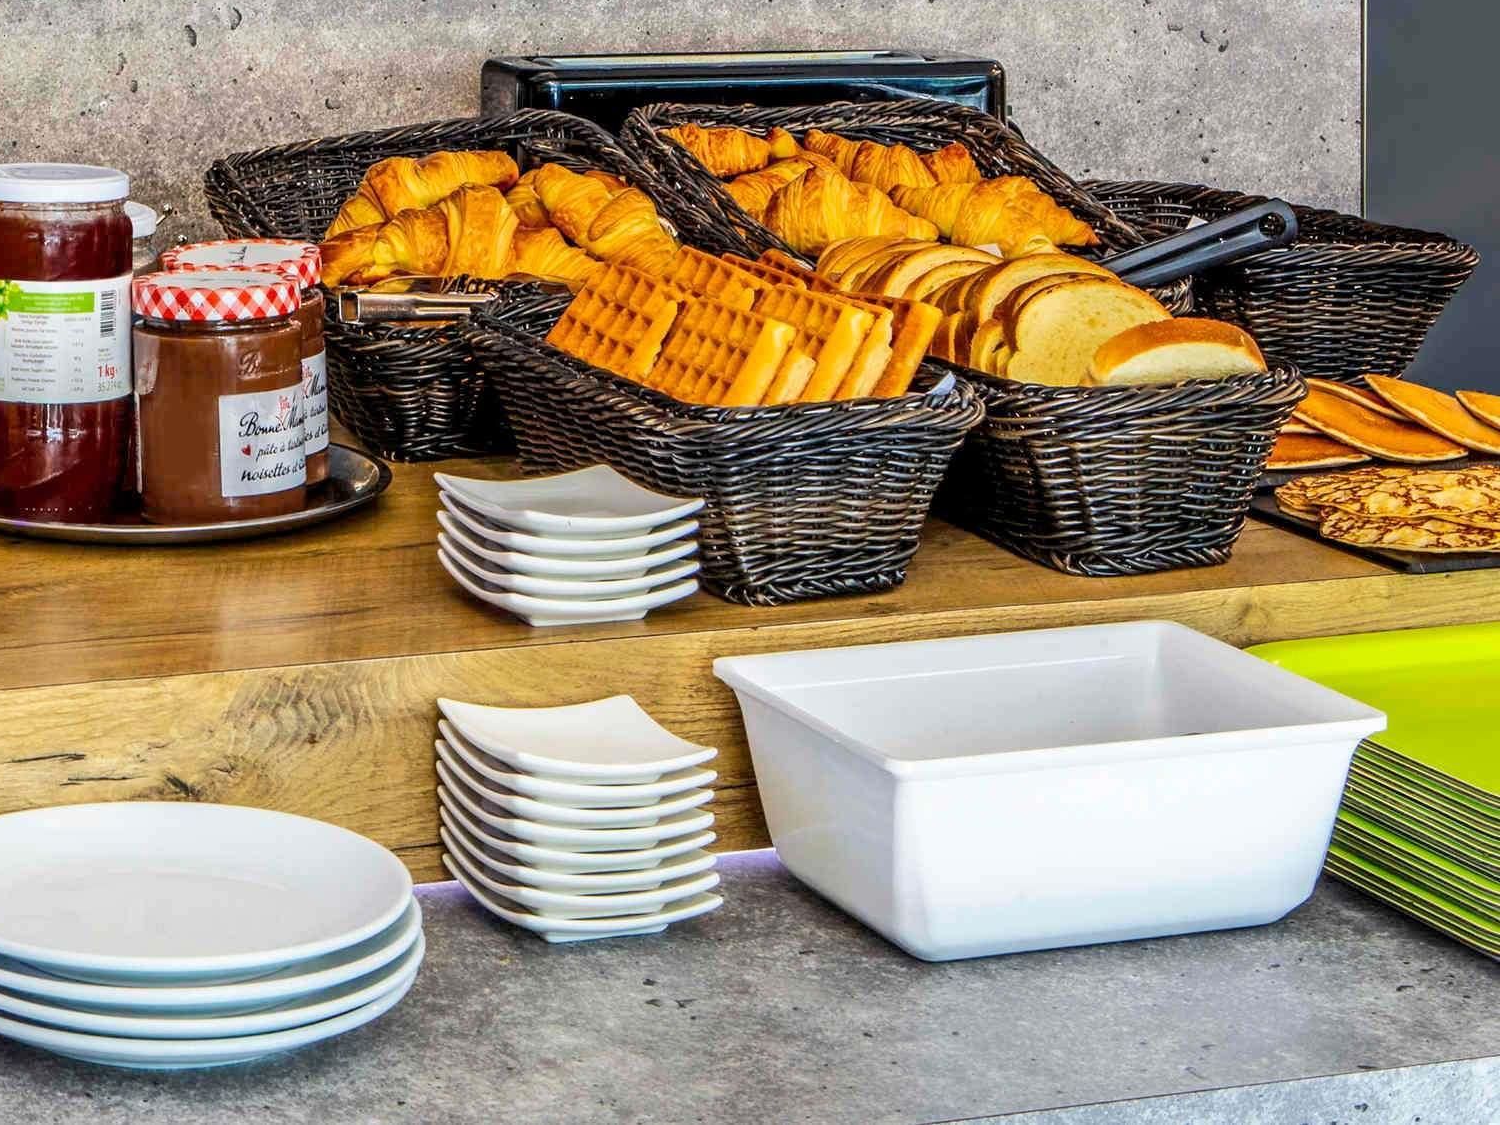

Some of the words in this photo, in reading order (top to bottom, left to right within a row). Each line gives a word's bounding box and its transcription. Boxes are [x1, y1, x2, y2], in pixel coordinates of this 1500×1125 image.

[238, 411, 282, 438] Bonne
[256, 442, 278, 463] pâte
[241, 462, 290, 482] noisettes
